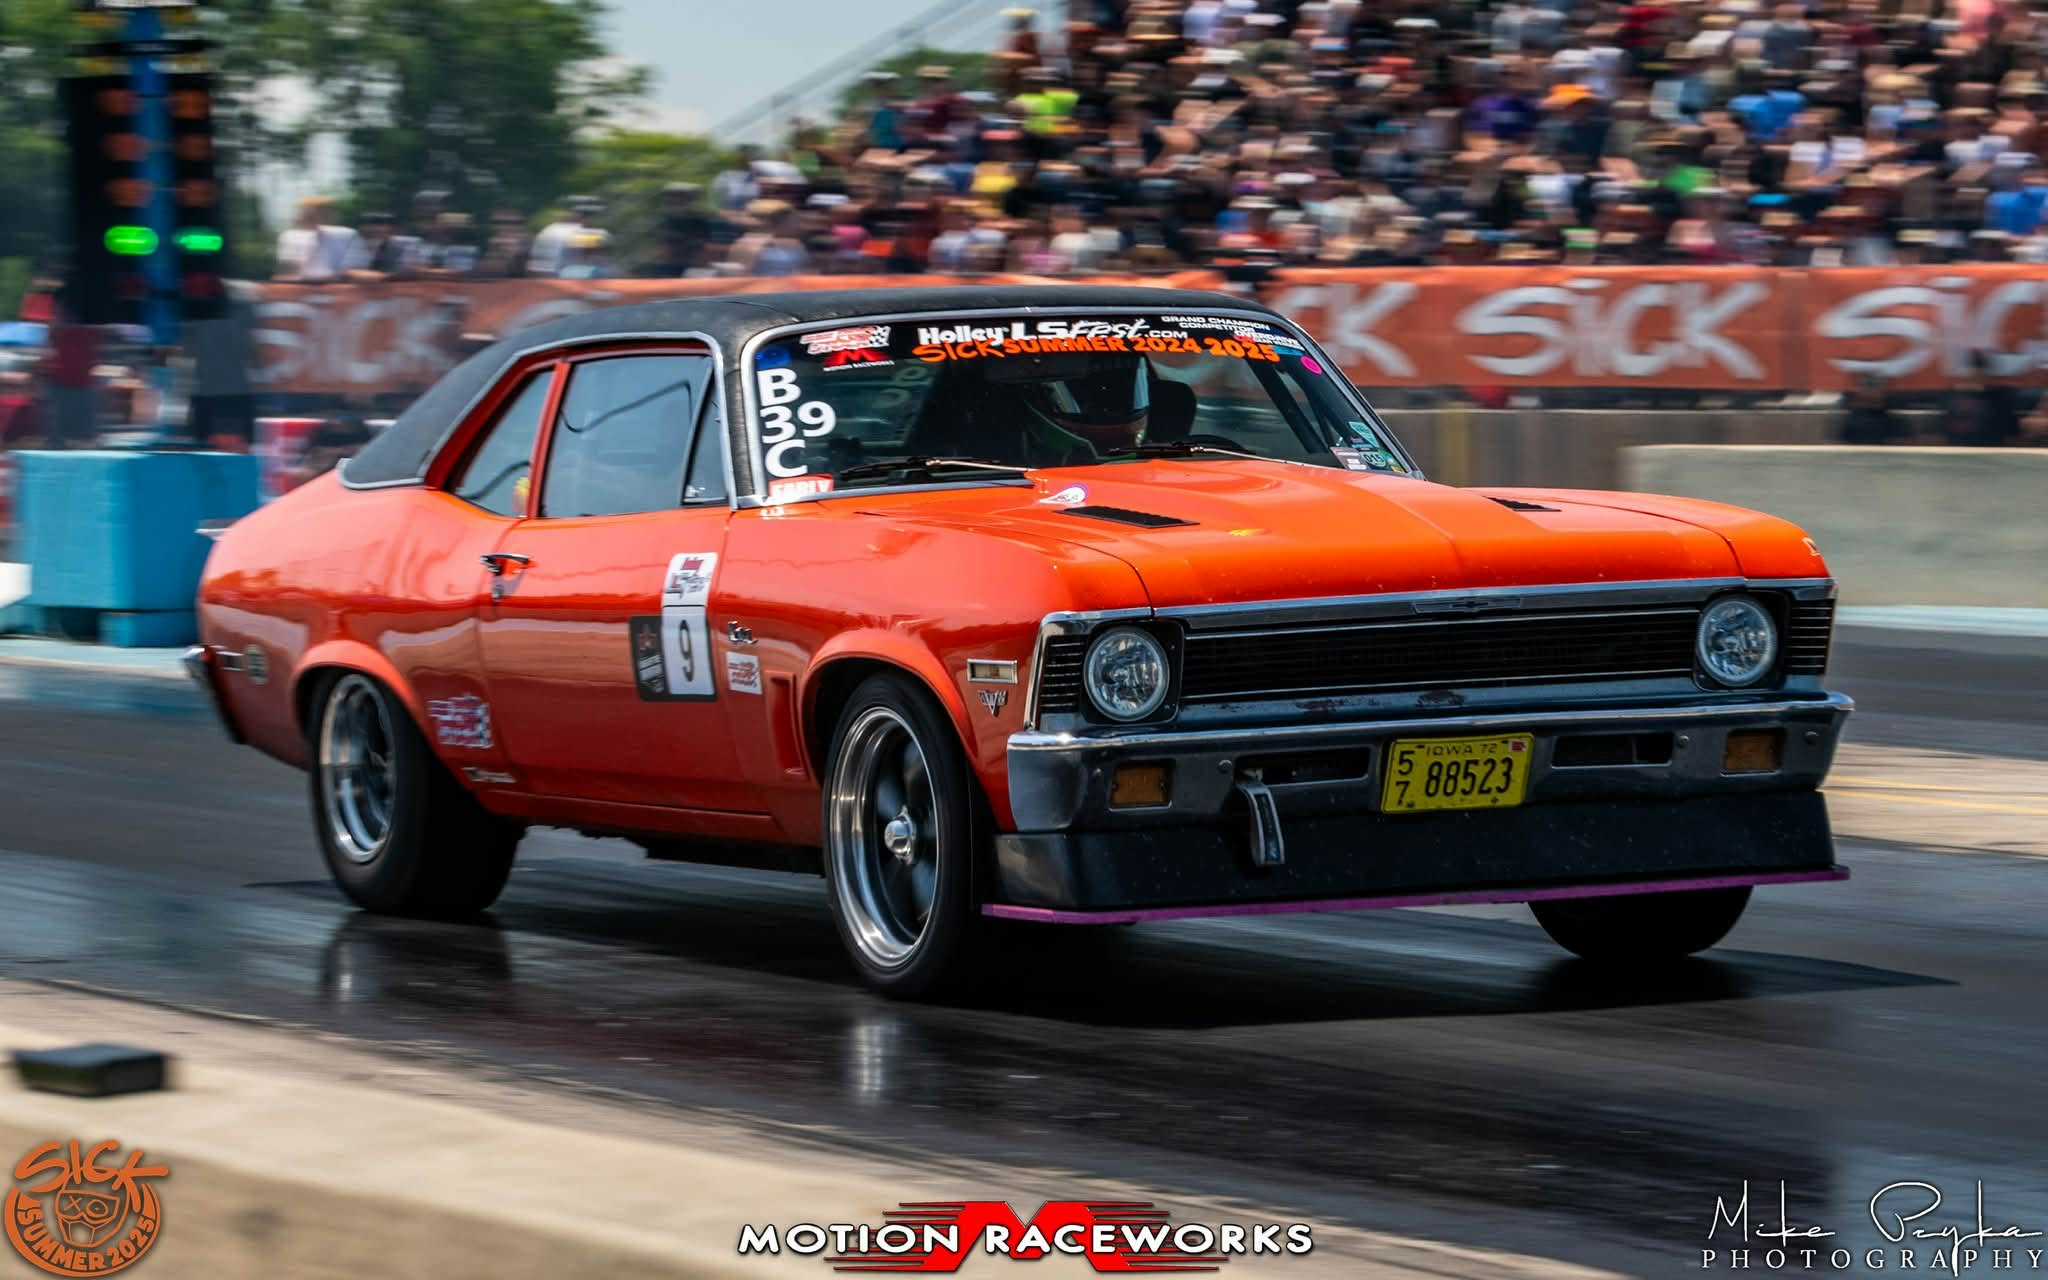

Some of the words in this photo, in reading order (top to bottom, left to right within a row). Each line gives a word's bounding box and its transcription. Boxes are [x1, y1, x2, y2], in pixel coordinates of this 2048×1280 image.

[917, 325, 1004, 346] Holley
[1161, 315, 1206, 323] GRAND
[1207, 316, 1271, 331] CHAMPION
[1179, 321, 1255, 333] COMPETITOR
[1816, 275, 2048, 376] SiC
[912, 338, 1005, 362] SICK
[1003, 336, 1130, 353] SUMMER
[1128, 337, 1202, 354] 2024
[1204, 337, 1280, 363] 2025
[757, 368, 801, 407] B
[765, 439, 808, 478] C
[679, 619, 695, 683] 9
[1426, 744, 1473, 756] IOWA
[1480, 743, 1498, 755] 72
[1425, 757, 1513, 797] 88523
